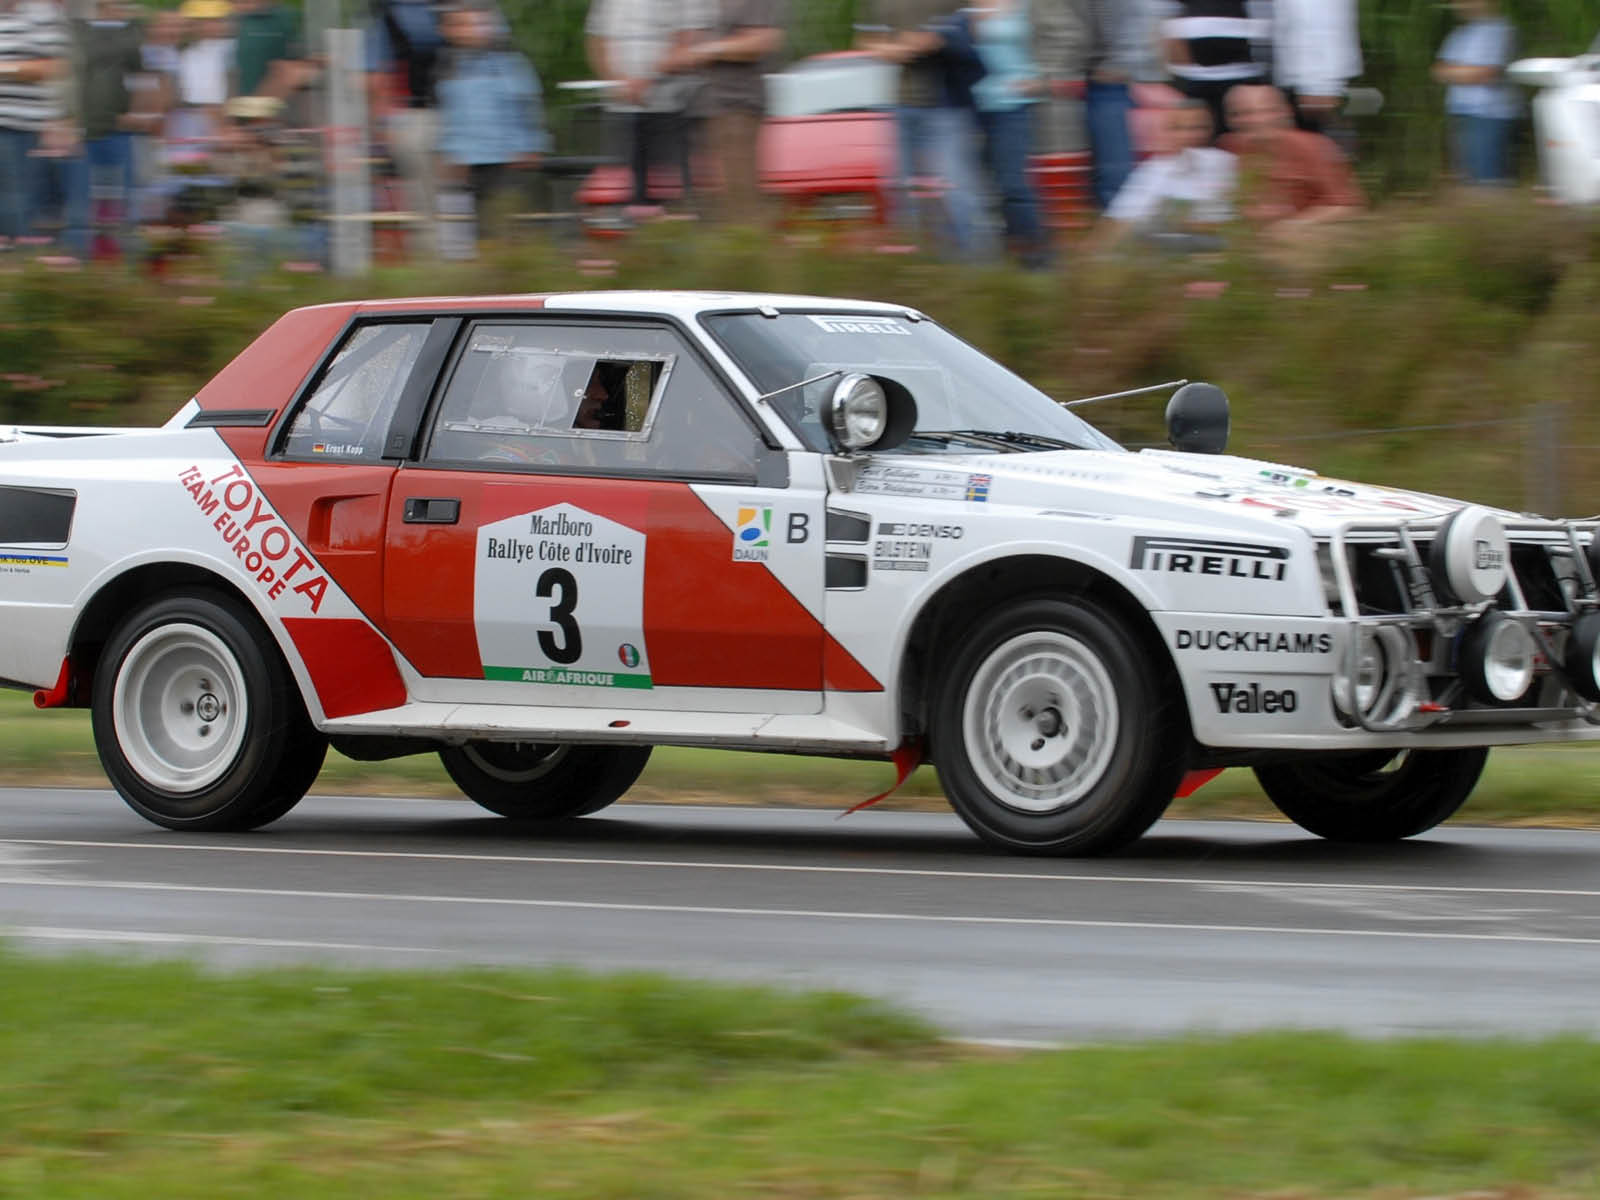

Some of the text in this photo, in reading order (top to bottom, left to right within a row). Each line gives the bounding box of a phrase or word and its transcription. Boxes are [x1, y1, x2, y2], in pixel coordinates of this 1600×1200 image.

[806, 315, 912, 335] PIRELLI
[177, 465, 286, 600] TEAM EUROPE
[530, 512, 593, 537] Marlboro
[786, 513, 809, 544] B
[909, 523, 964, 540] DENSO
[210, 463, 329, 614] TOYOTA
[487, 538, 633, 565] Rallye Côte d'Ivoire
[874, 541, 931, 559] BILSTEIN
[734, 548, 768, 561] DAUN
[1130, 536, 1290, 581] PIRELLI
[535, 567, 583, 665] 3
[1175, 629, 1332, 654] DUCKHAMS
[522, 669, 615, 687] AIR AFRIQUE
[1208, 682, 1297, 714] Valeo
